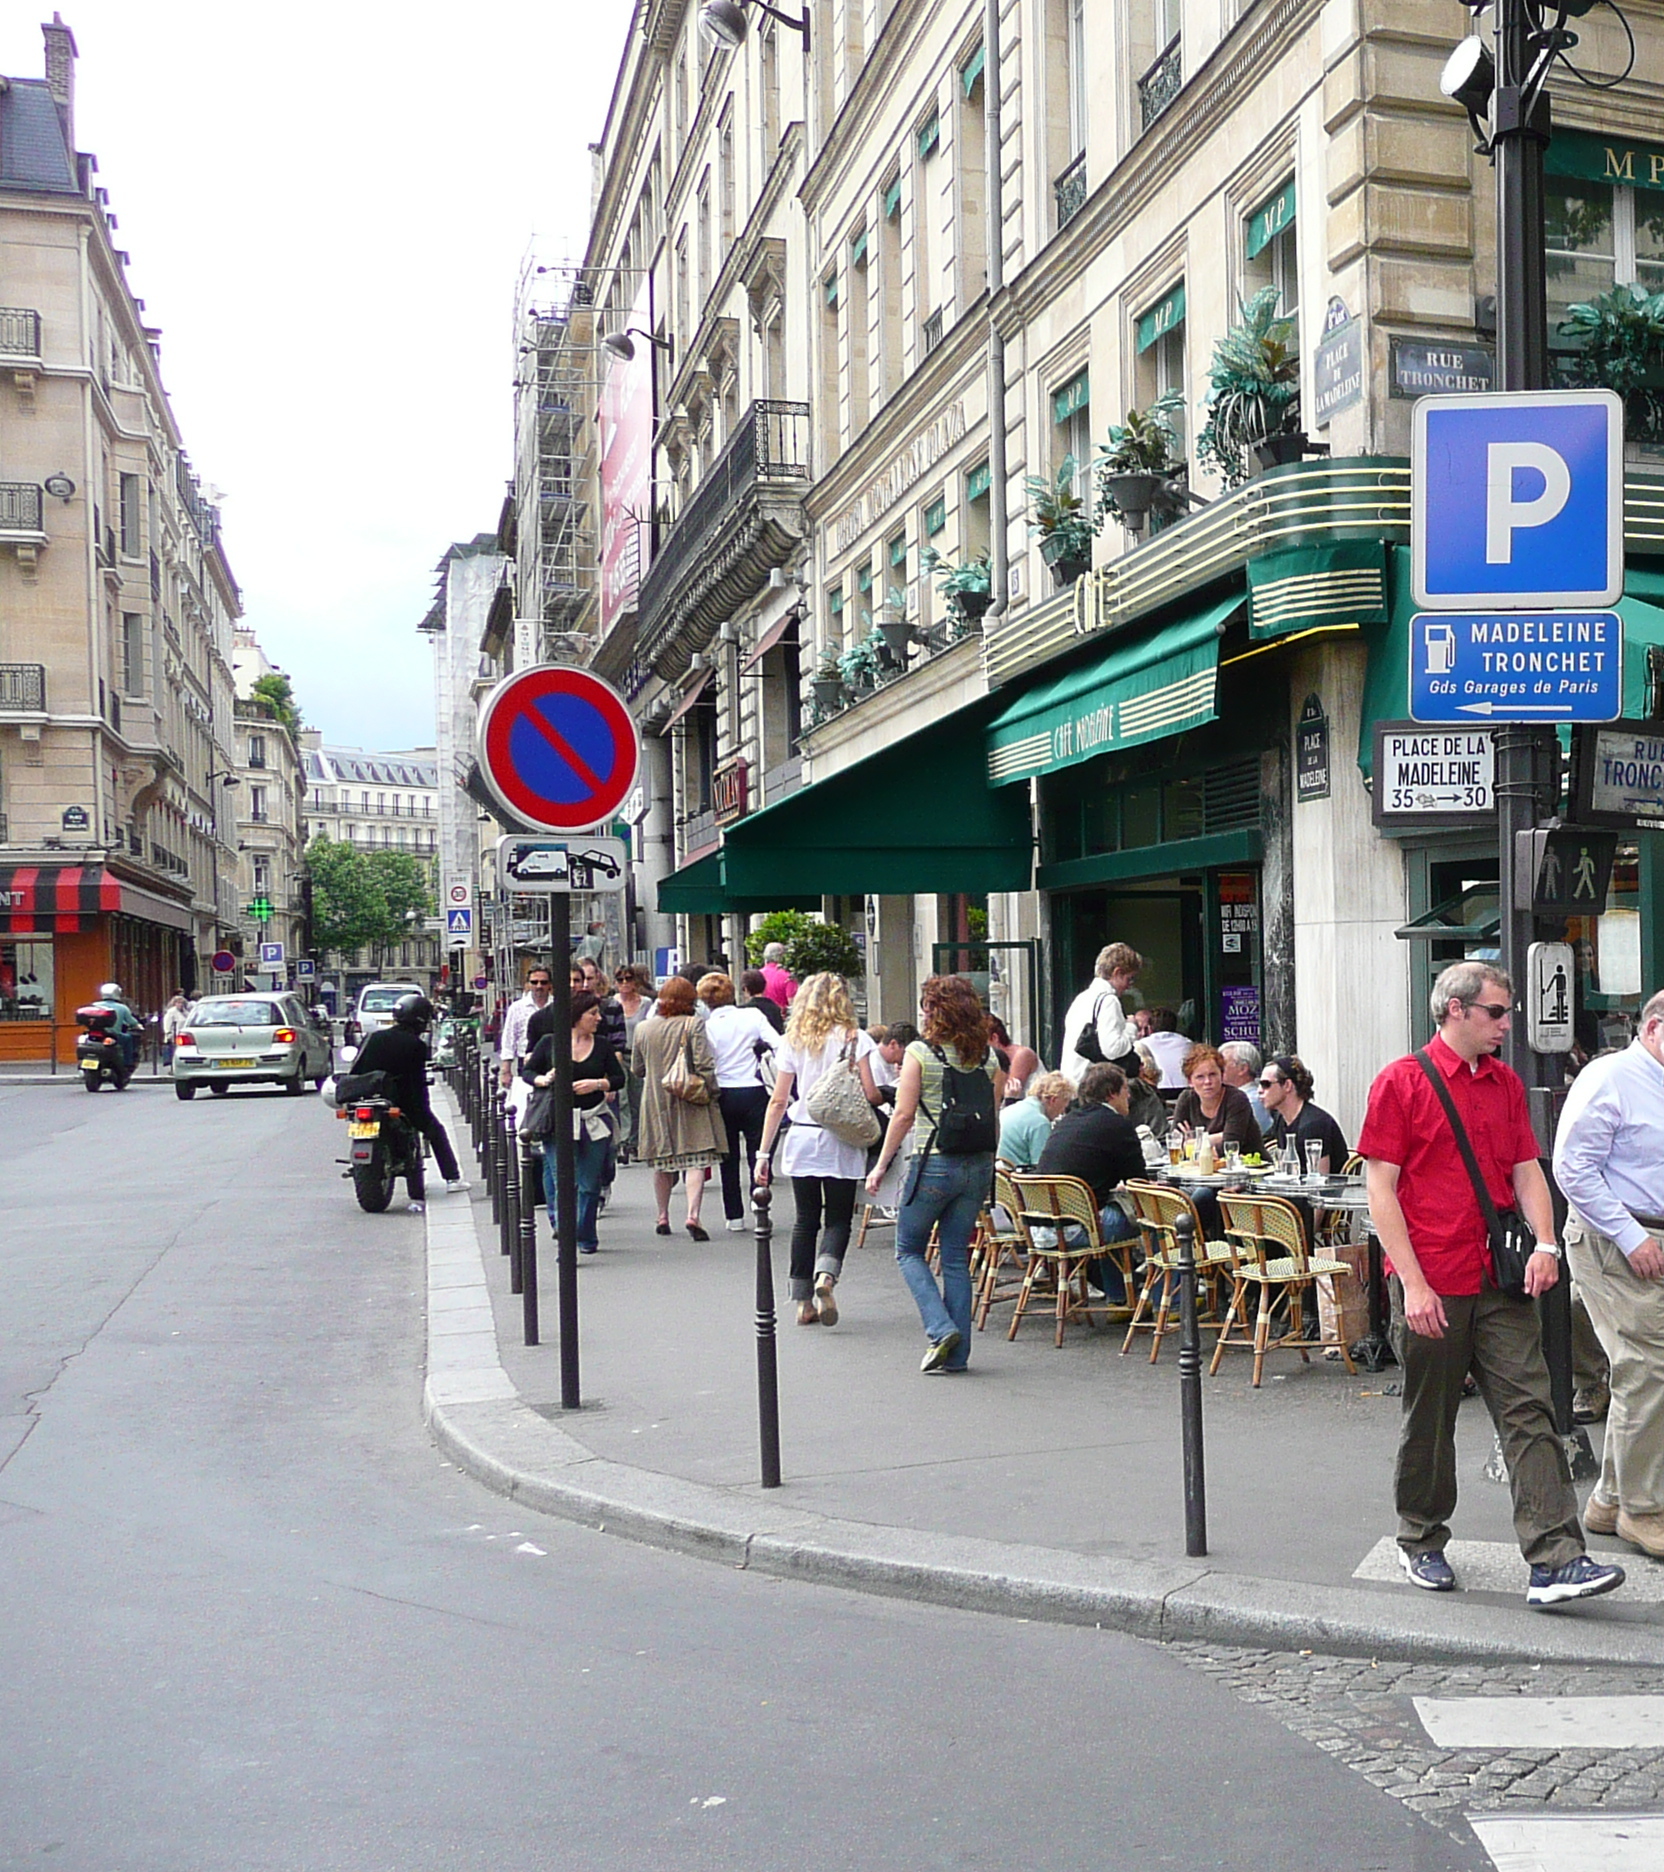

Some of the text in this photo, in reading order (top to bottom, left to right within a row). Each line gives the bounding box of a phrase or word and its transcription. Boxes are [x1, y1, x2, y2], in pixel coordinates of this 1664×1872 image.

[1326, 342, 1349, 370] PLACE
[1426, 352, 1463, 369] RUE
[1333, 368, 1342, 382] DE
[1401, 370, 1489, 392] TRONCHET
[1324, 371, 1361, 408] MADELEINE
[1486, 442, 1571, 564] P
[1471, 622, 1606, 643] MADELEINE
[1482, 652, 1605, 672] TRONCHET
[1429, 679, 1599, 697] Gds Garages de Paris
[1304, 732, 1320, 752] PLACE
[1392, 736, 1485, 757] PLACE DE LA
[1300, 768, 1327, 789] MADELEINE
[1398, 761, 1480, 786] MADELEINE
[1392, 786, 1486, 808] 35 30
